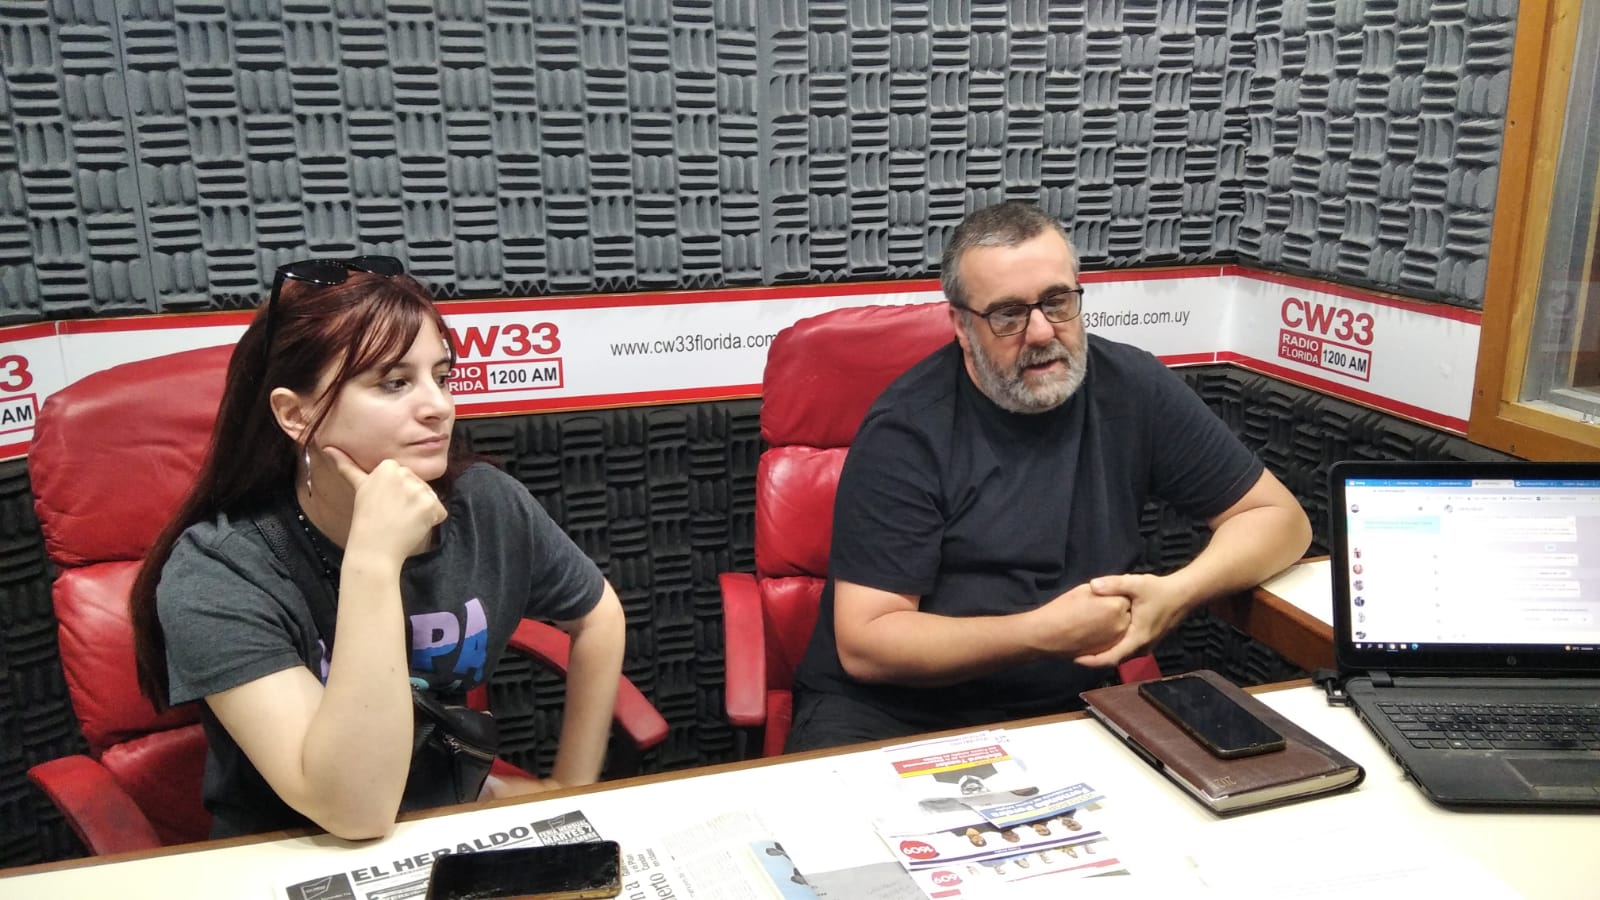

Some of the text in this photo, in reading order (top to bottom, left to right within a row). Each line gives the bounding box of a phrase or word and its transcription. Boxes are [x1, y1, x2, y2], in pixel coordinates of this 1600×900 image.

[1083, 310, 1190, 328] 33florida.com.uy
[1281, 297, 1375, 346] CW33
[450, 322, 561, 359] W33
[610, 332, 777, 356] www.cw33florida.com
[1282, 333, 1319, 352] RADIO
[1281, 346, 1319, 364] FLORIDA
[1323, 349, 1367, 373] 1200 AM
[449, 366, 482, 380] DIO
[490, 367, 557, 385] 1200 AM
[448, 380, 484, 392] RIDA
[2, 405, 32, 424] AM
[350, 865, 389, 882] EL
